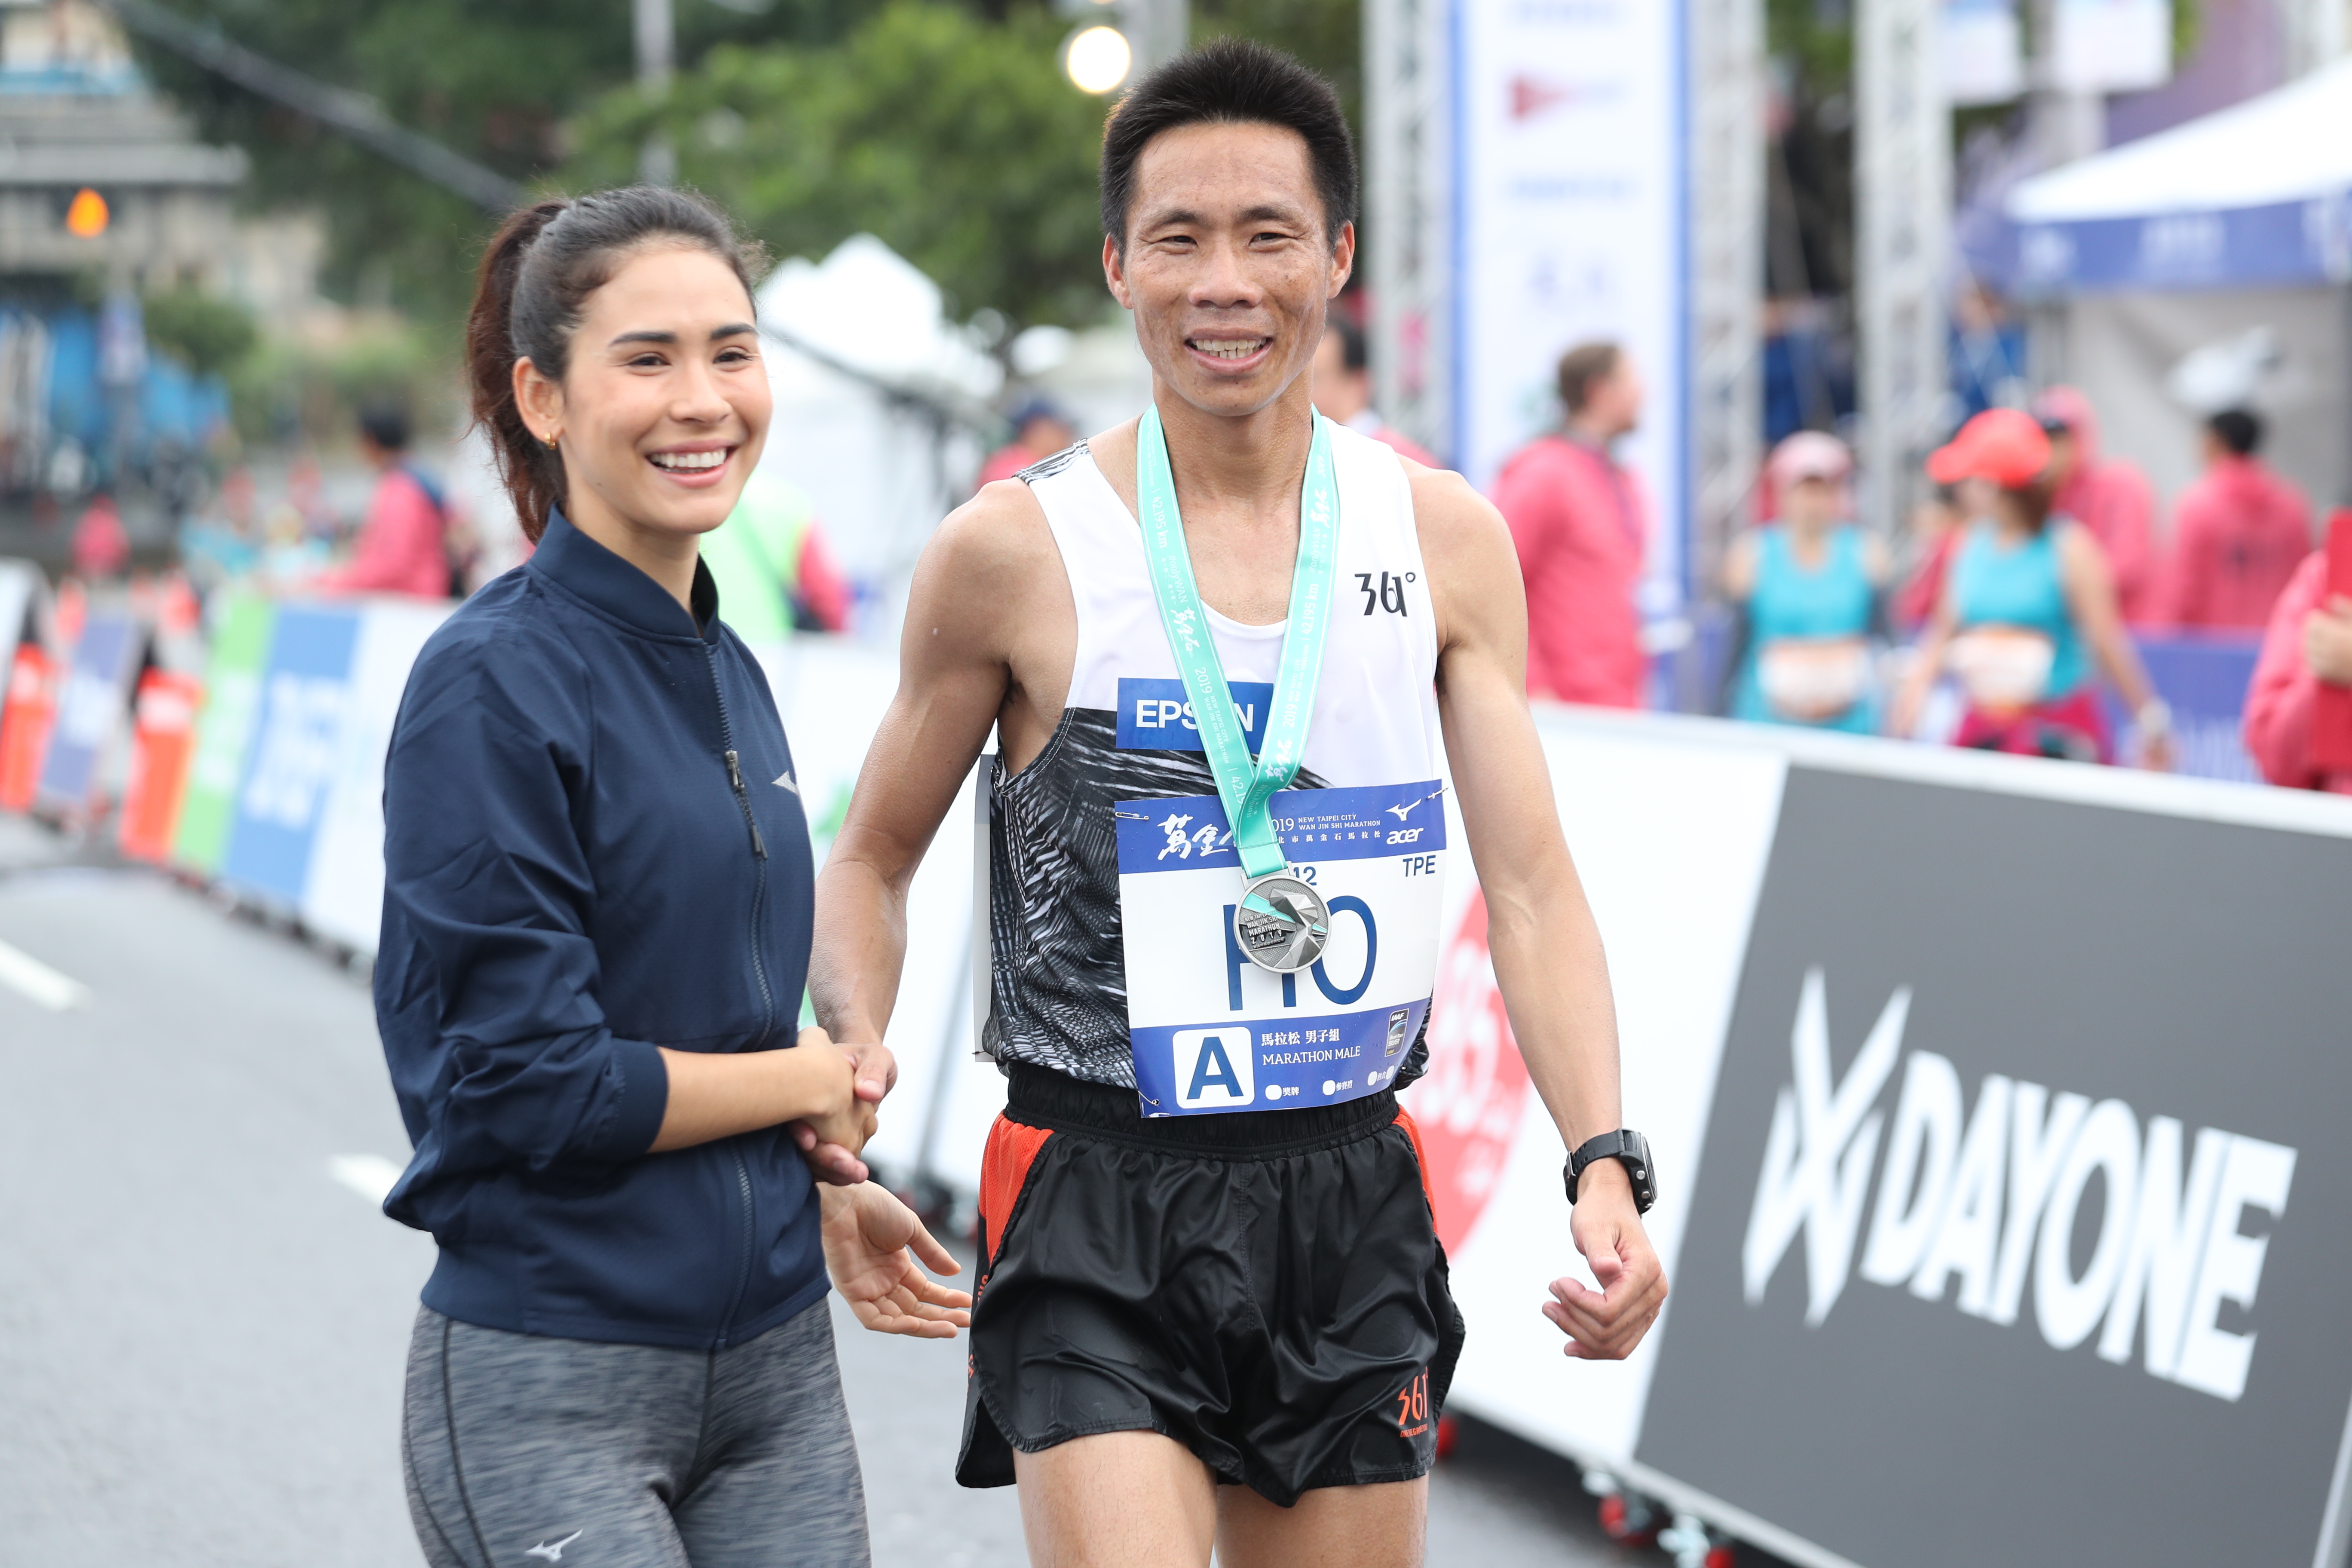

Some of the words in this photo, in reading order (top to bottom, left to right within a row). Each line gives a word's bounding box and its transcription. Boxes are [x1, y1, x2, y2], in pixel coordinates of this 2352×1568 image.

[1152, 496, 1167, 529] 42.195
[1157, 530, 1169, 548] km
[1308, 527, 1321, 573] #onlyWAN
[1169, 555, 1188, 603] #onlyWAN
[1305, 583, 1319, 600] km
[1301, 602, 1316, 634] 42.195
[1194, 667, 1213, 694] 2019
[1136, 699, 1254, 732] EPSN
[1210, 695, 1219, 708] NEW
[1215, 709, 1224, 728] TAIPEI
[1283, 704, 1297, 728] 2019
[1204, 697, 1213, 711] WAN
[1216, 732, 1230, 764] MARATHON
[1231, 776, 1247, 810] 42.19
[1158, 813, 1236, 860] 萬金
[1272, 818, 1294, 832] 019
[1386, 827, 1424, 845] acer
[1278, 830, 1381, 844] 北市萬金石馬拉松
[1403, 854, 1436, 877] TPE
[1246, 921, 1259, 929] WAN
[1259, 918, 1268, 926] JIN
[1248, 922, 1280, 937] MARATHON
[1391, 1012, 1405, 1022] IAAF
[1261, 1031, 1301, 1046] 馬拉松
[1305, 1028, 1340, 1044] 男子組
[1388, 1038, 1400, 1047] SILVER
[1262, 1050, 1332, 1065] MARATHON
[1335, 1045, 1361, 1060] MALE
[1187, 1036, 1244, 1099] A
[1283, 1087, 1300, 1096] 獎牌
[1859, 1049, 2299, 1403] DAYONE
